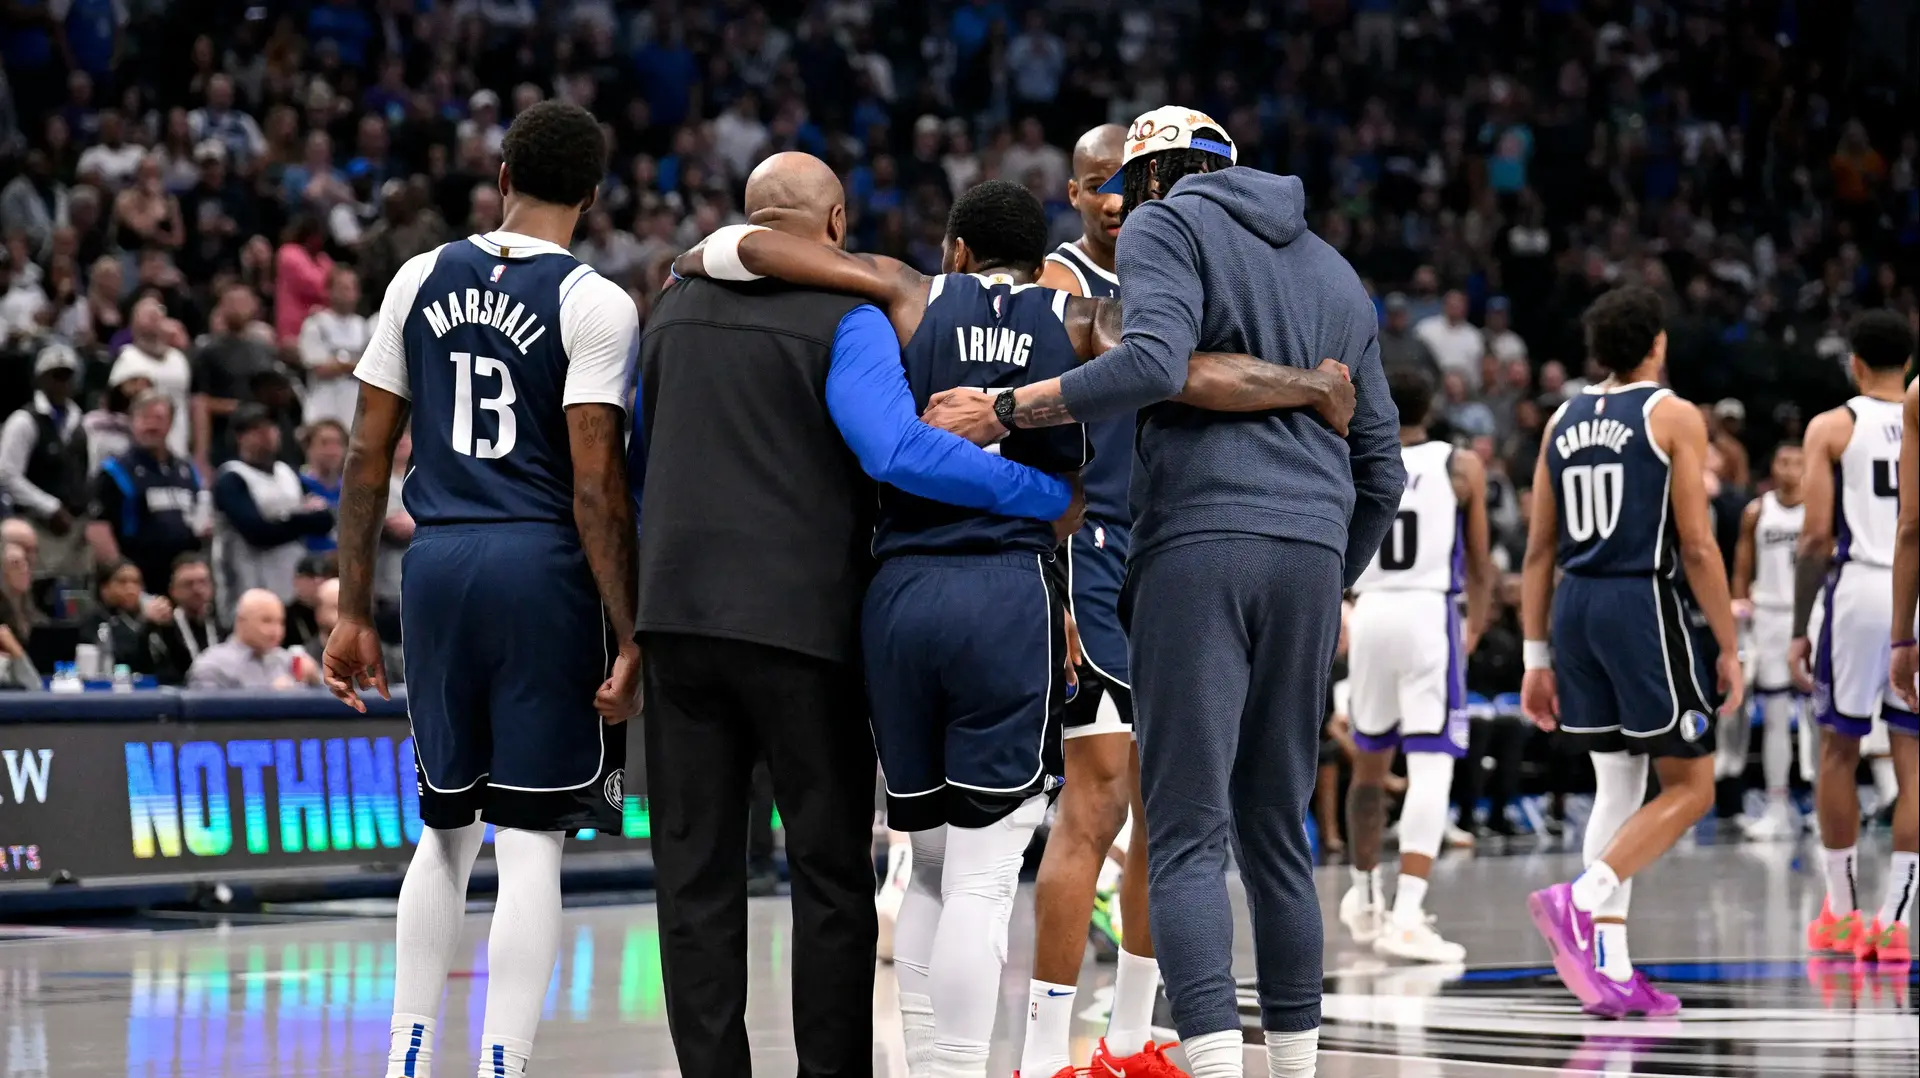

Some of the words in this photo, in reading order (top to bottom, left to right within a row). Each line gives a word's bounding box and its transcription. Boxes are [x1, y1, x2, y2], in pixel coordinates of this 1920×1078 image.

[423, 288, 546, 355] MARSHALL
[956, 325, 1033, 367] IRVNG
[450, 352, 517, 459] 13
[1555, 418, 1634, 460] CHRISTIE
[1562, 463, 1624, 542] 00
[0, 748, 54, 804] W
